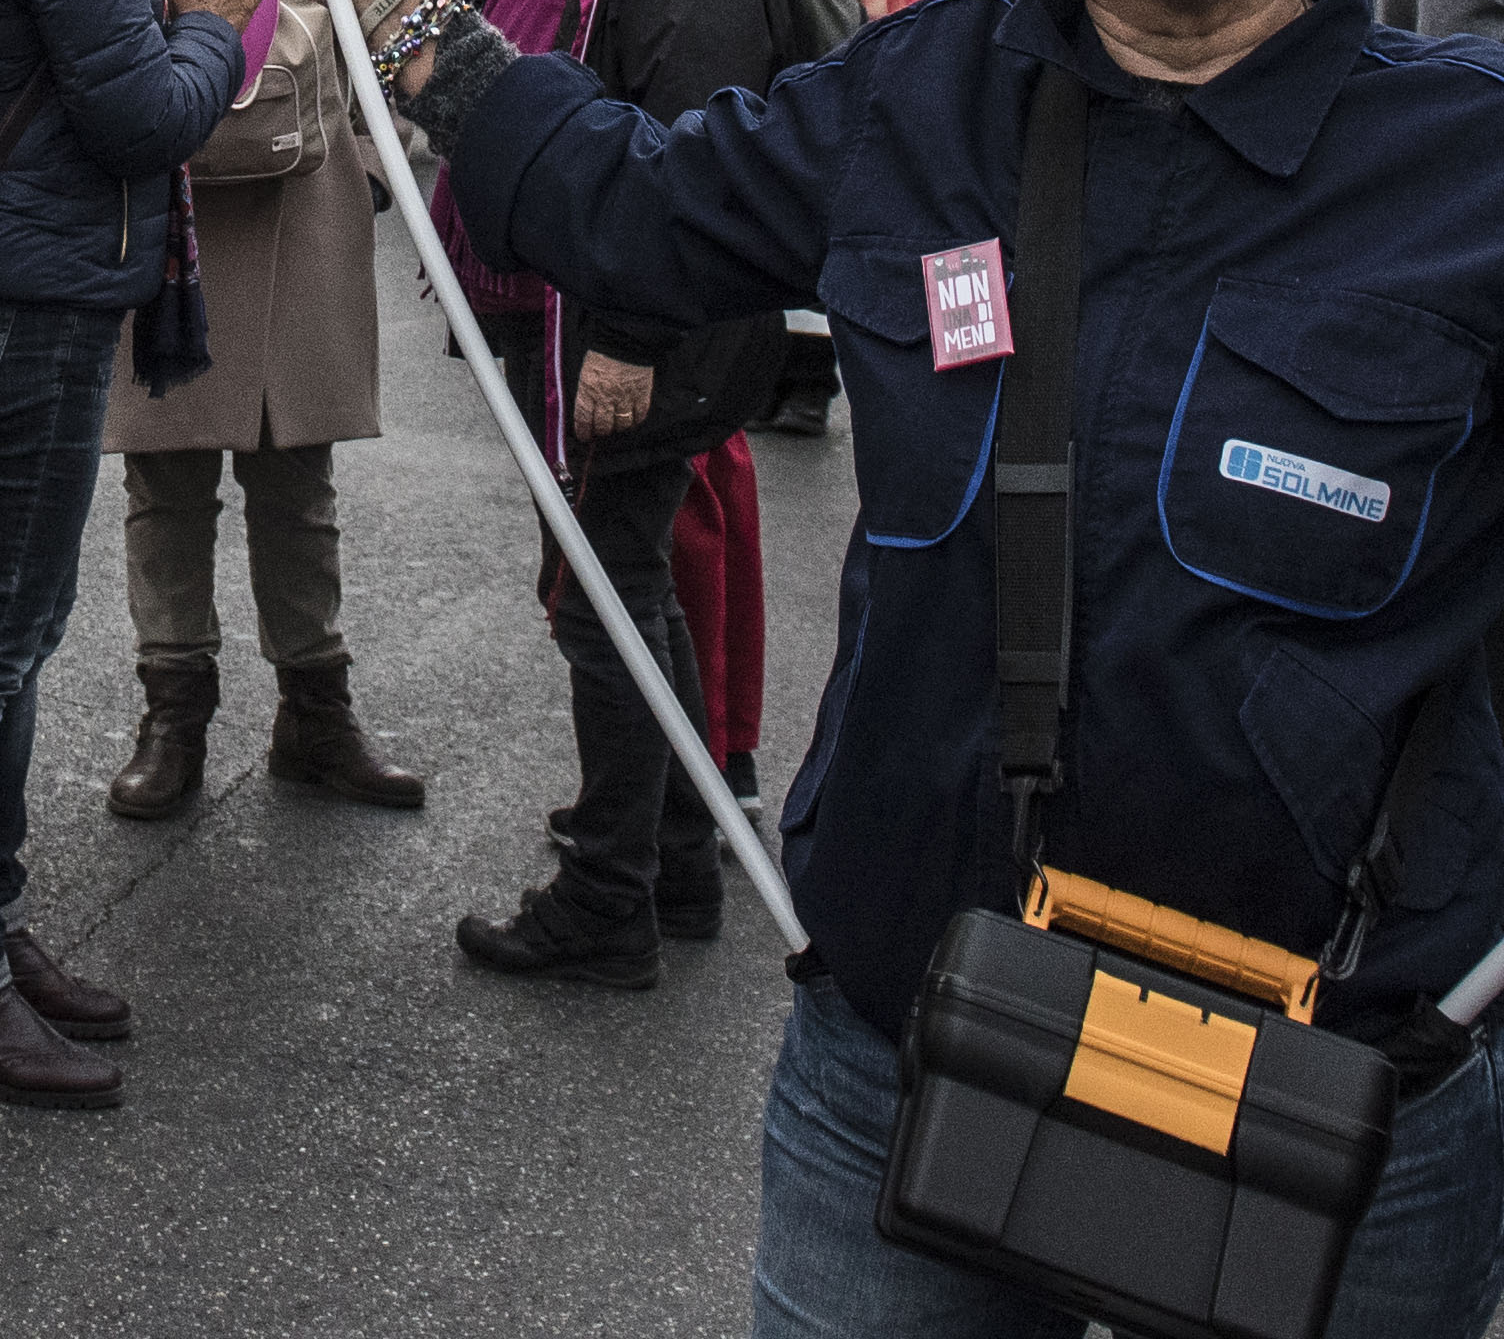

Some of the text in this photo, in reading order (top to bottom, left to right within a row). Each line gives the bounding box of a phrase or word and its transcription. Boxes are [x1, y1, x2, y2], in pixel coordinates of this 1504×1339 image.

[936, 269, 991, 311] NON
[977, 300, 994, 322] DI
[943, 320, 997, 354] MENO
[1266, 453, 1307, 473] NUOVA
[1261, 465, 1386, 520] SOLMINE
